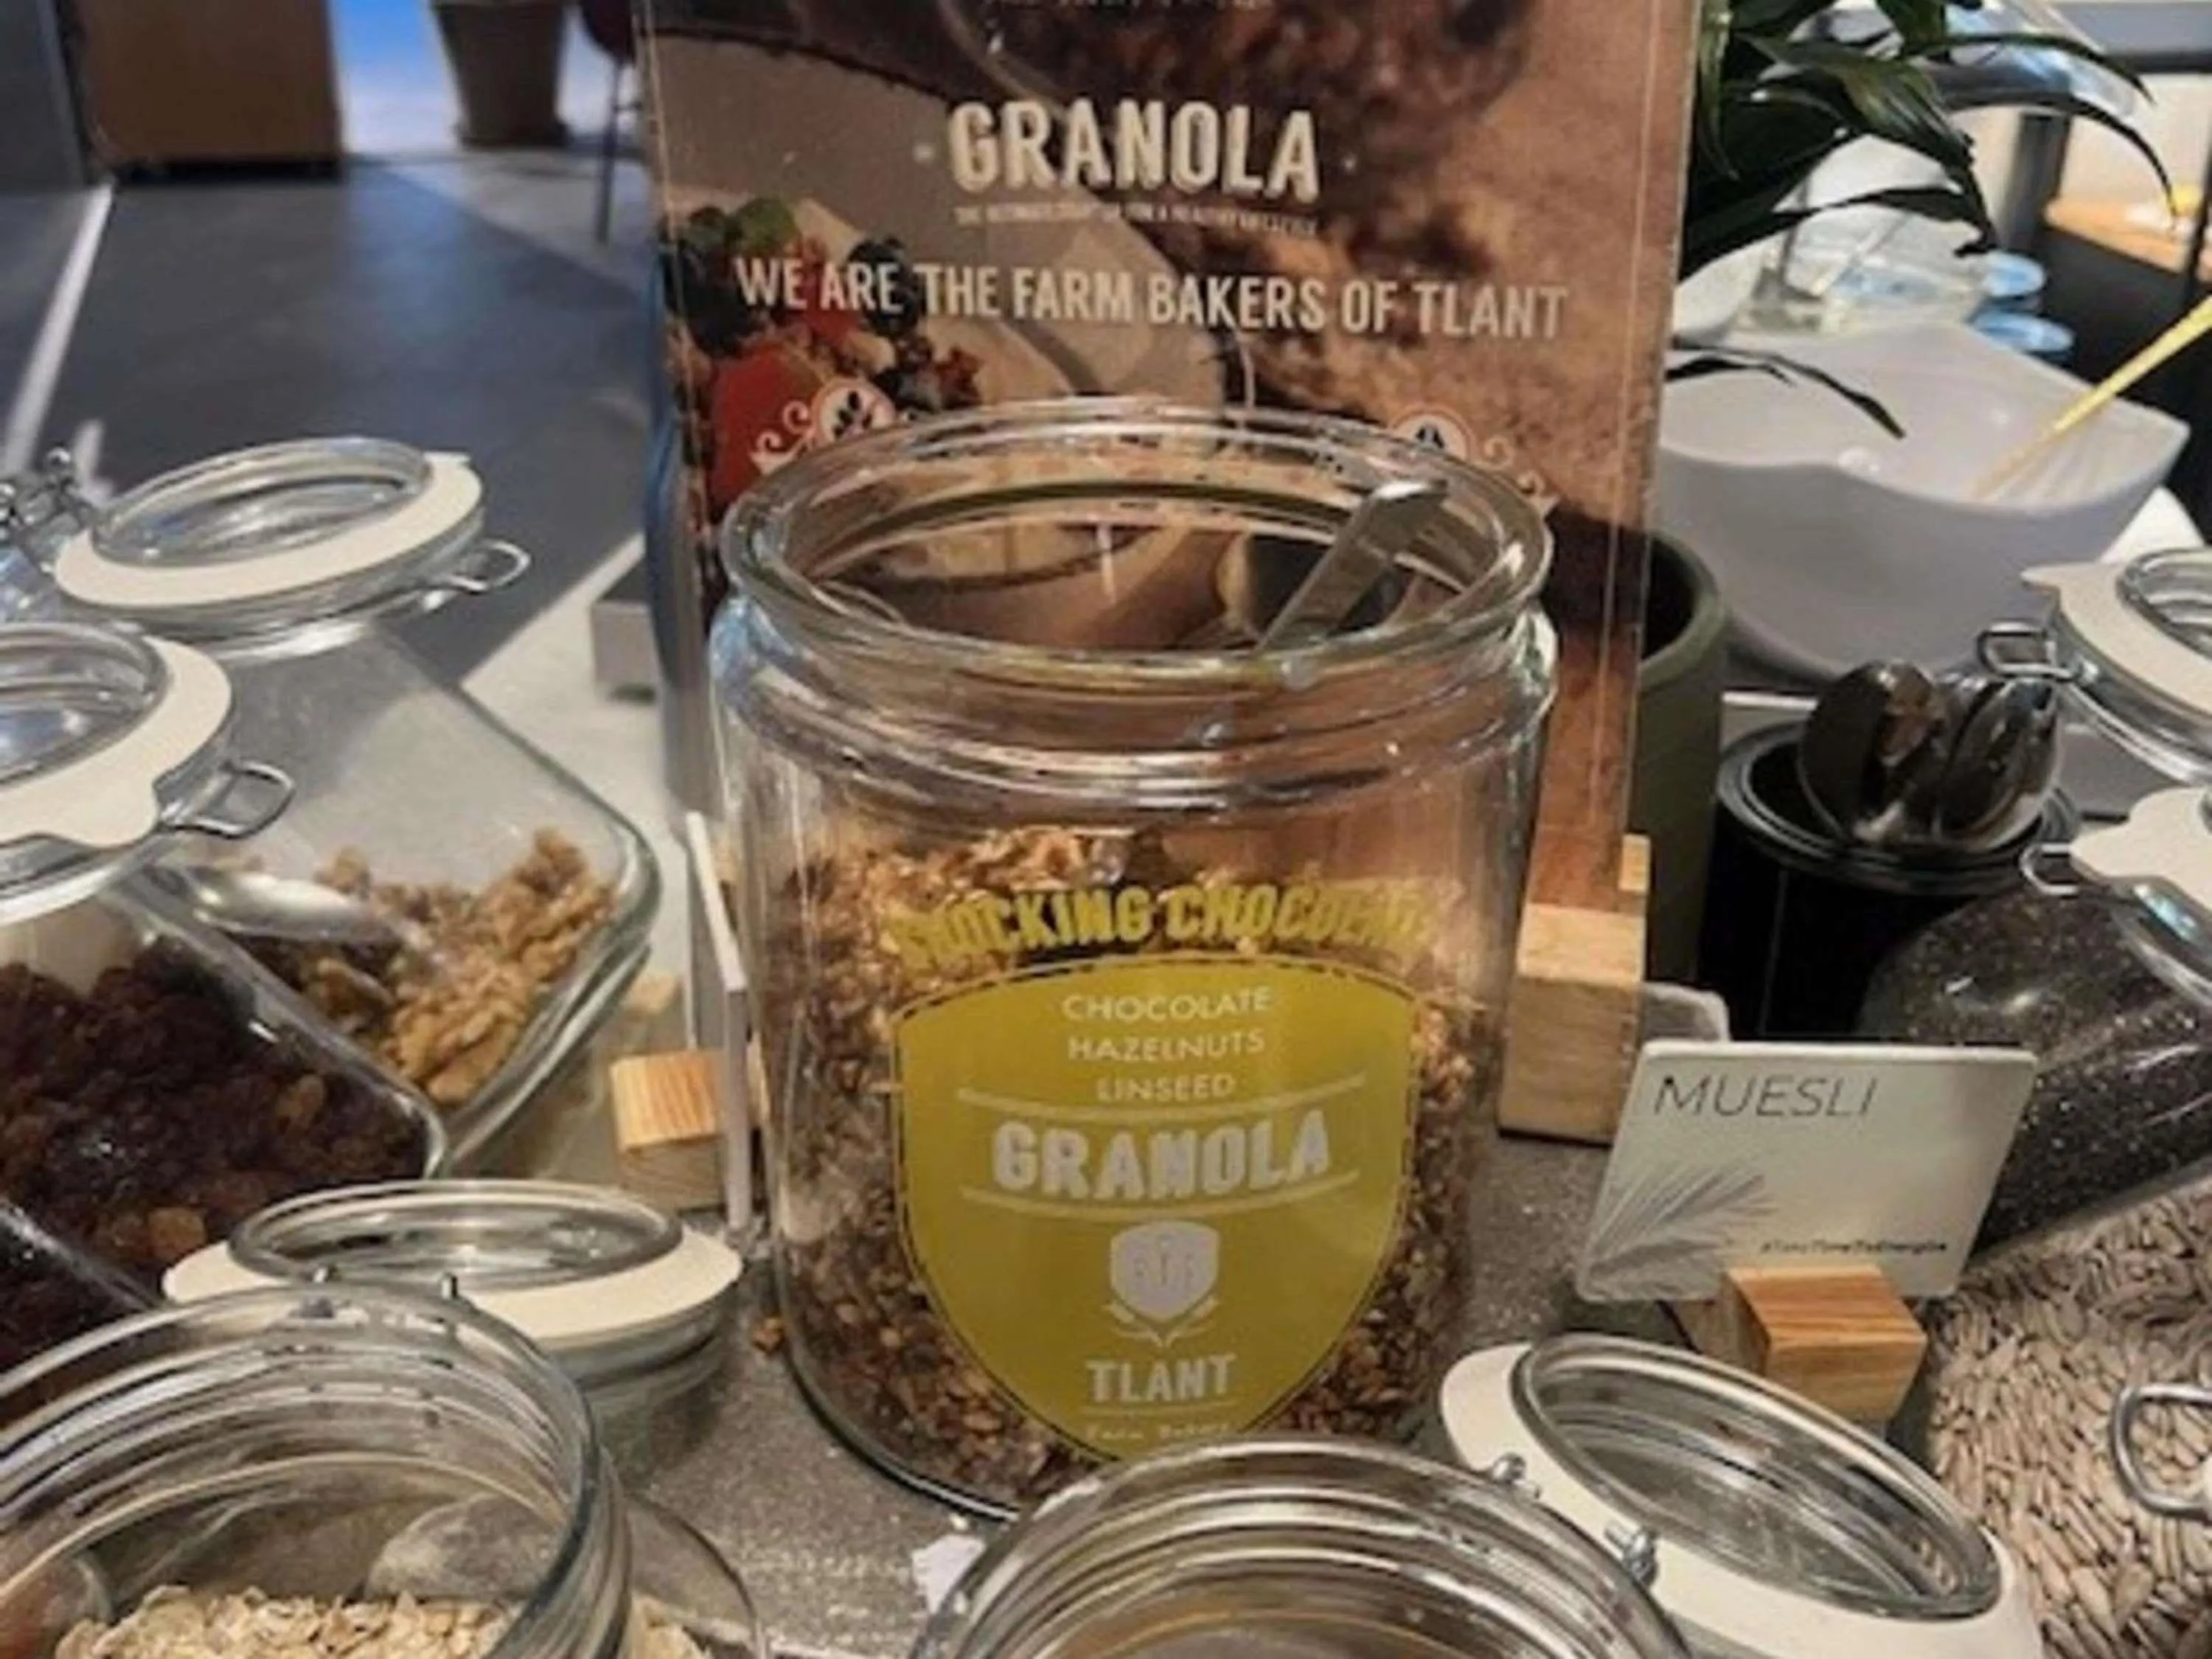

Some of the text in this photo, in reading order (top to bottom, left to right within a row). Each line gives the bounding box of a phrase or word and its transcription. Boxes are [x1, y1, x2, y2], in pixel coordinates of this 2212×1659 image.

[949, 97, 1321, 204] GRANOLA
[735, 257, 1568, 339] WE ARE THE FARM BAKERS OF TLANT
[1062, 985, 1273, 1023] CHOCOLATE
[1068, 1029, 1265, 1062] HAZELNUTS
[1097, 1074, 1237, 1103] LINSEED
[1655, 1074, 1879, 1117] MUESLI
[990, 1109, 1330, 1202] GRANOLA
[1085, 1352, 1238, 1402] TLANT
